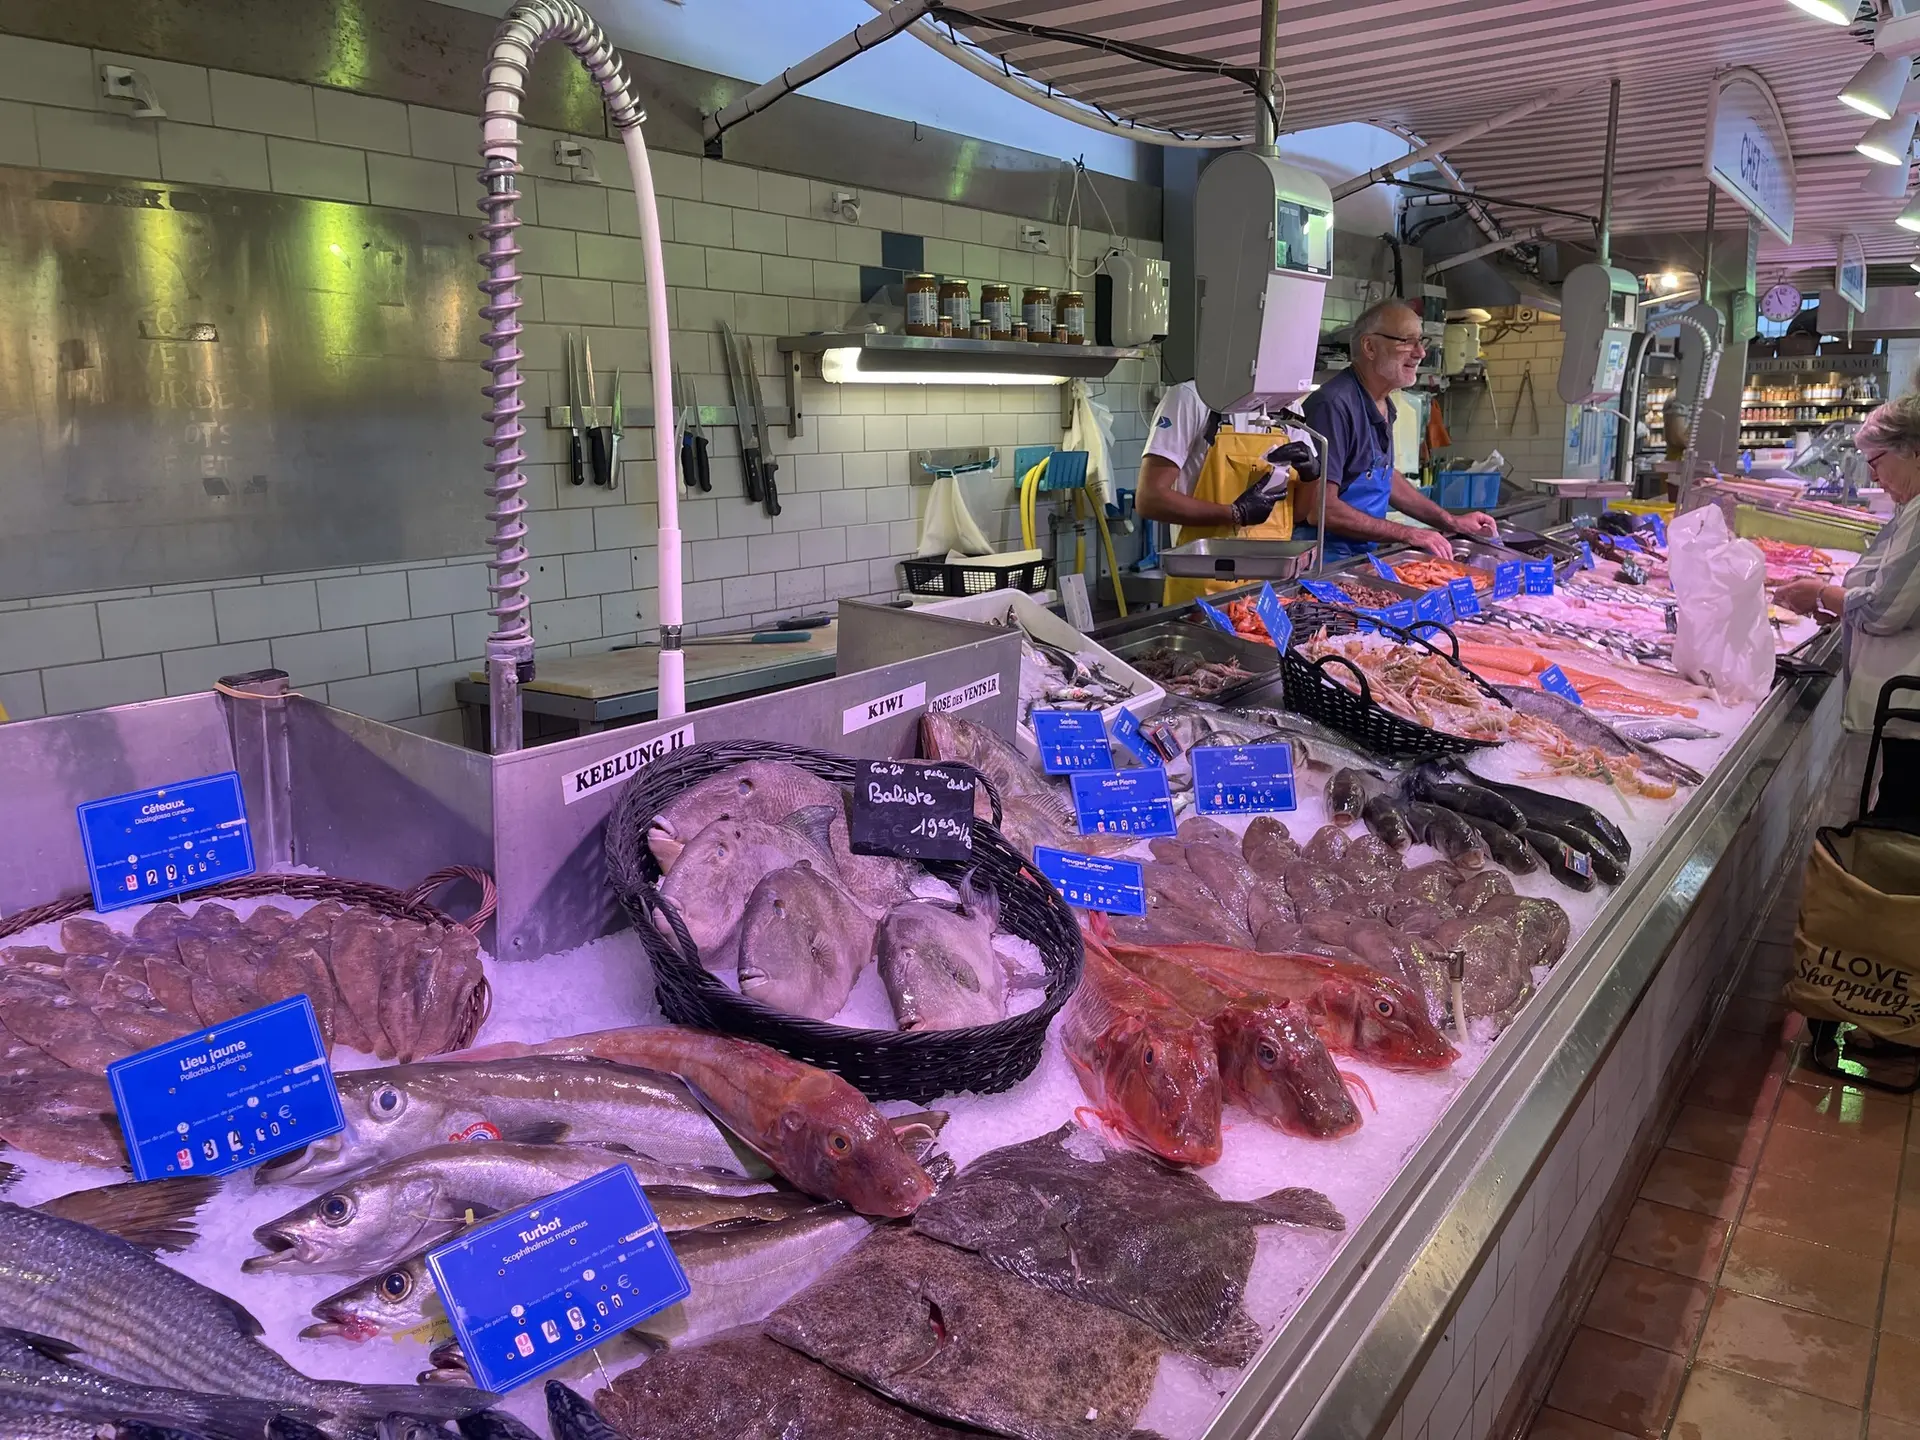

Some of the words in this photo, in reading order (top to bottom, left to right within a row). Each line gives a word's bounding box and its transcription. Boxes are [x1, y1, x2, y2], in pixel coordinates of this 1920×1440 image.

[1741, 132, 1760, 191] CHEZ
[867, 694, 904, 720] KIWI
[932, 695, 952, 713] ROSE
[952, 694, 963, 706] DES
[964, 682, 988, 702] VENTS
[987, 678, 997, 693] LR
[575, 739, 665, 793] KEELUNG
[669, 730, 685, 752] II
[141, 799, 185, 816] Céteaux
[868, 782, 936, 805] Baliste
[206, 849, 216, 860] €
[1818, 946, 1828, 965] I
[1831, 949, 1914, 991] LOVE
[1796, 958, 1910, 1012] Shopping
[179, 1055, 207, 1072] Lieu
[208, 1040, 248, 1062] jaune
[179, 1064, 217, 1082] Pollachius
[216, 1051, 253, 1071] pollachius
[278, 1104, 292, 1119] €
[502, 1237, 556, 1265] Scophthalmus
[555, 1220, 589, 1242] maximus
[518, 1216, 562, 1244] Turbot
[616, 1273, 631, 1289] €
